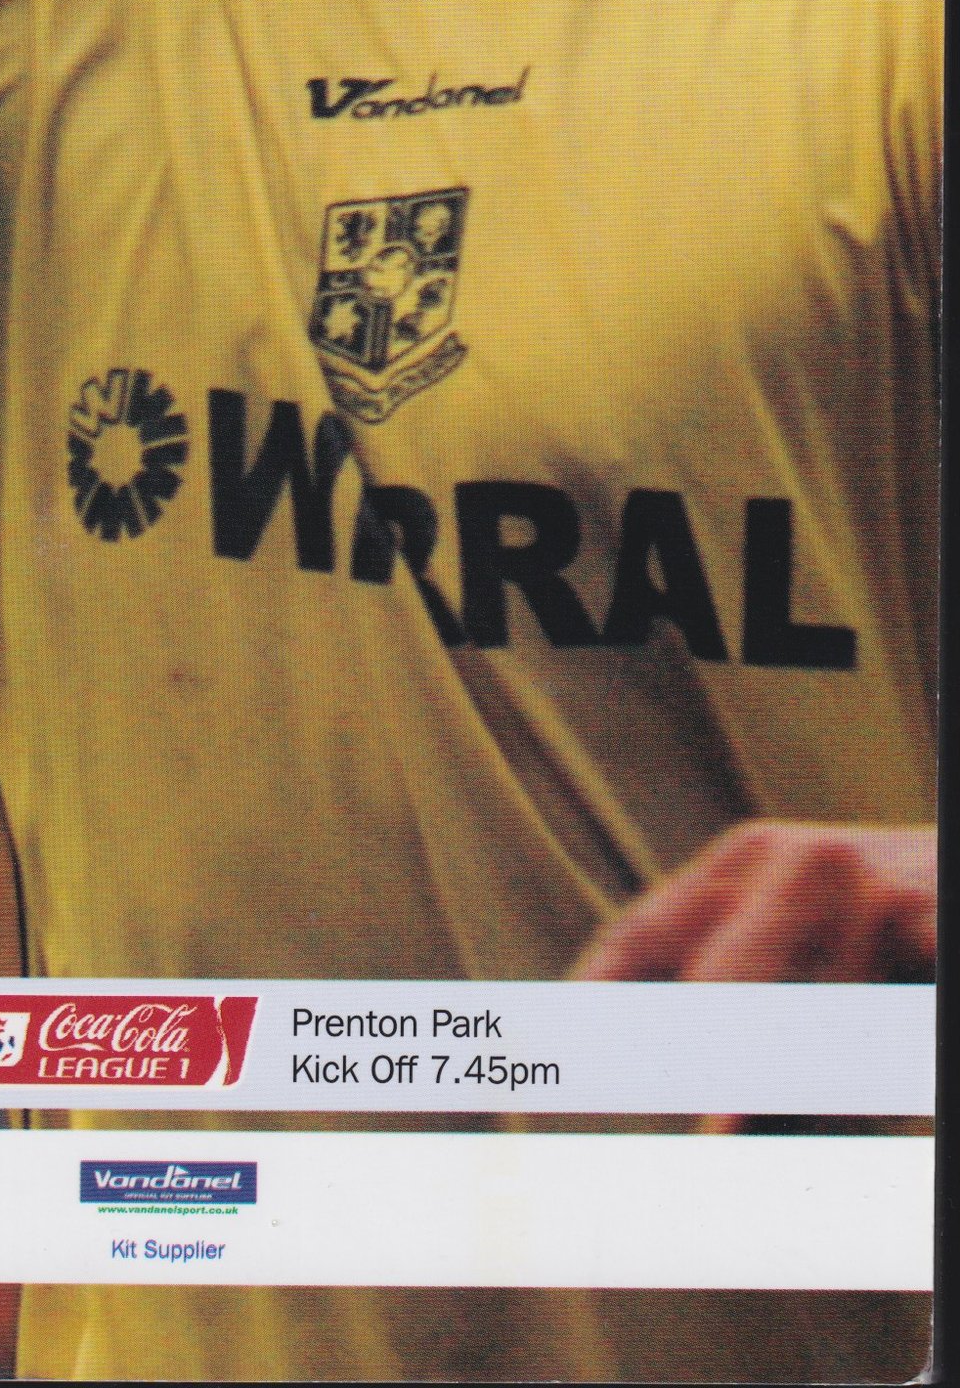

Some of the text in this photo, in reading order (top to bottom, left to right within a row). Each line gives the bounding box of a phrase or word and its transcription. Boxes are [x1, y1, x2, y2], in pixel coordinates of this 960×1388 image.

[306, 67, 530, 121] Vandanel
[292, 1009, 503, 1039] Prenton Park
[38, 1057, 190, 1079] LEAGUE 1
[292, 1055, 561, 1091] Kick Off 7.45pm
[95, 1165, 243, 1189] Vandanel
[112, 1240, 226, 1262] Kit Supplier
